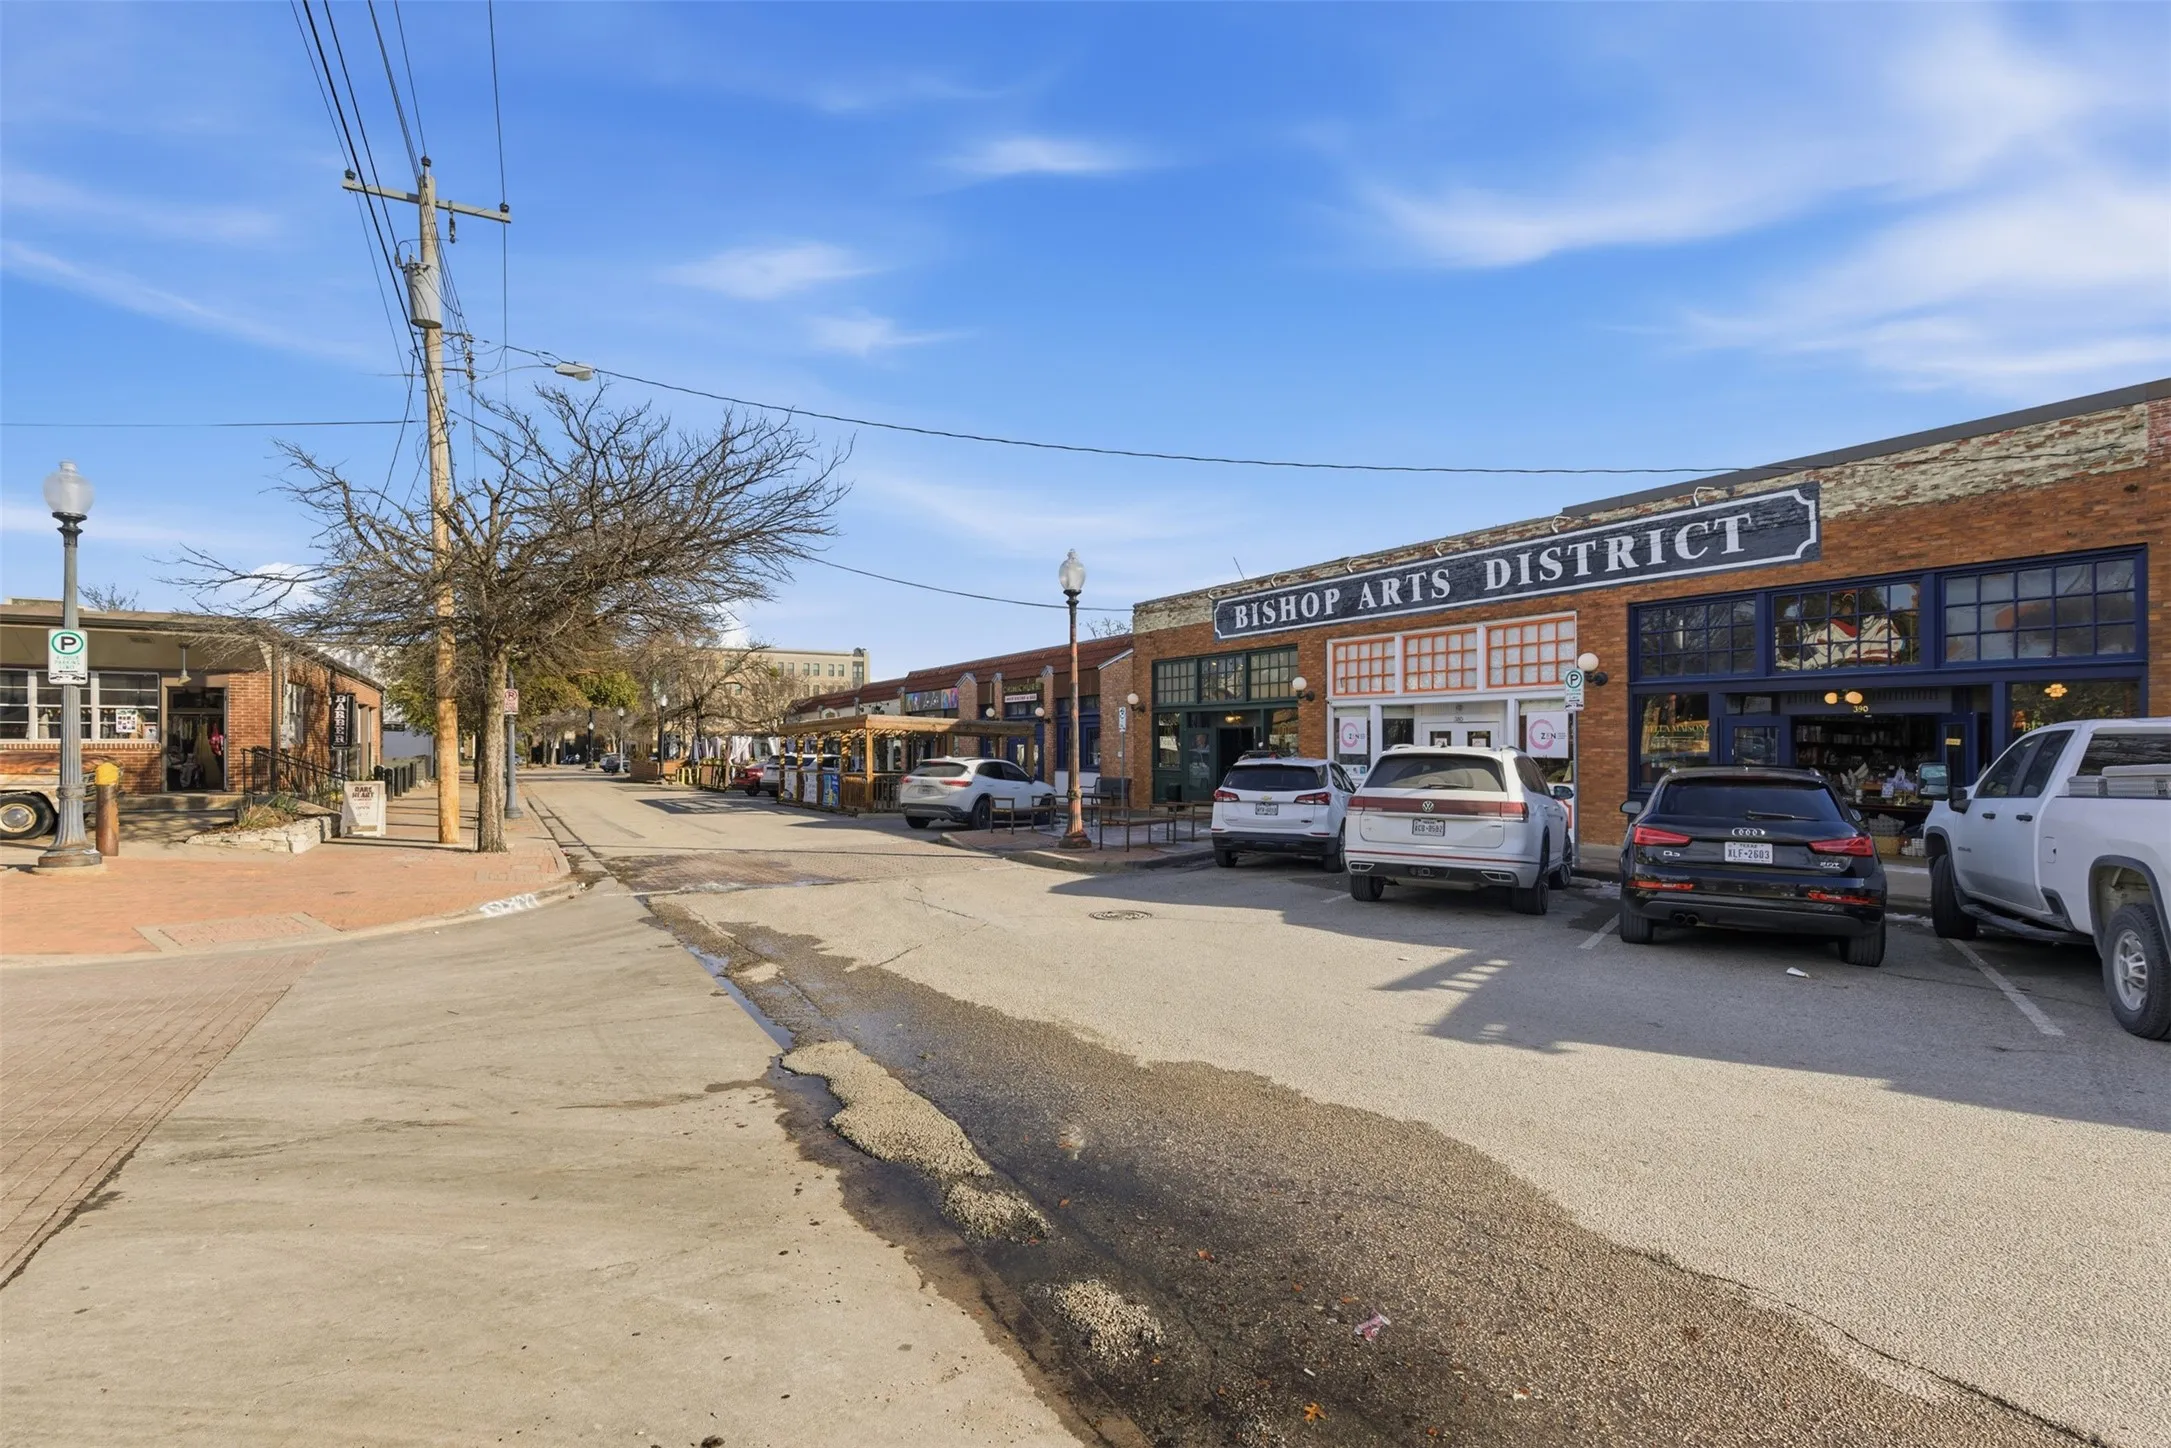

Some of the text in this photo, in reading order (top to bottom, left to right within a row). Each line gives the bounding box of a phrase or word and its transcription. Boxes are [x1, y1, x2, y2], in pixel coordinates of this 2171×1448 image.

[1234, 512, 1752, 629] BISHOP ARTS DISTRICT
[61, 636, 76, 650] P
[1570, 674, 1579, 686] P
[1853, 705, 1869, 713] 390
[334, 694, 347, 743] BARBER
[1671, 724, 1705, 732] MAISON
